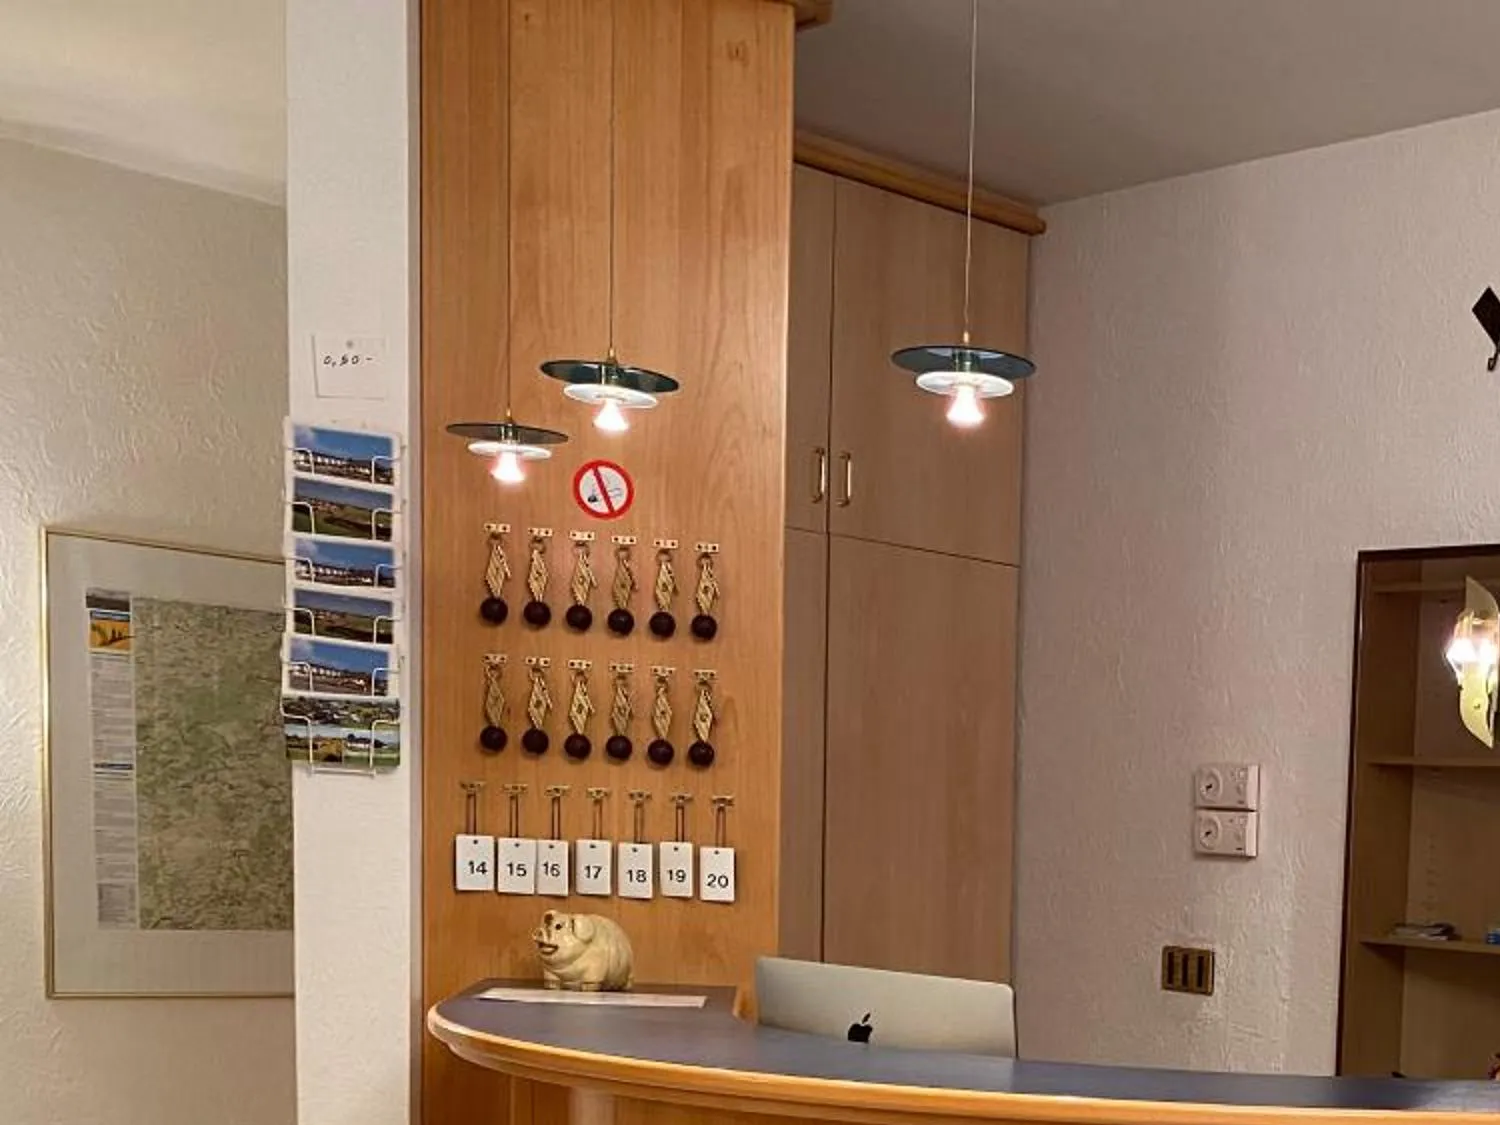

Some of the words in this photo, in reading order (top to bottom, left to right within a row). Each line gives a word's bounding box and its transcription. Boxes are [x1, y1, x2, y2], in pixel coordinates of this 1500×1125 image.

[468, 860, 488, 875] 14
[506, 862, 527, 877] 15
[543, 862, 561, 877] 16
[584, 864, 602, 880] 17
[626, 868, 646, 884] 18
[667, 868, 687, 883] 19
[707, 873, 729, 889] 20
